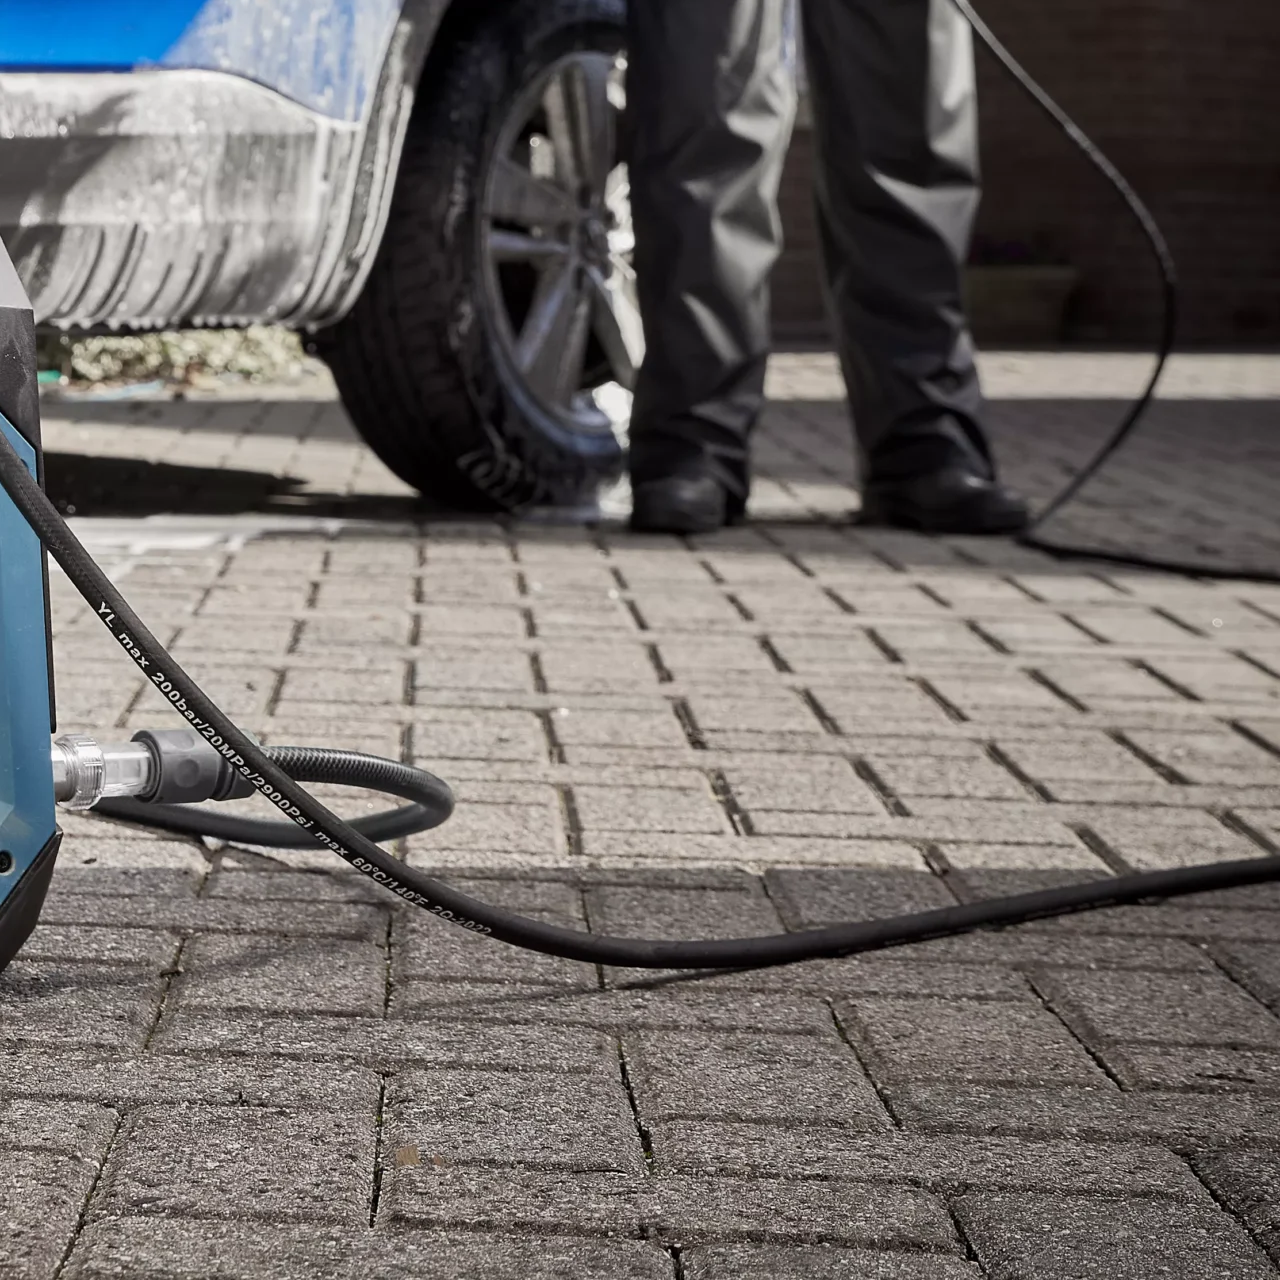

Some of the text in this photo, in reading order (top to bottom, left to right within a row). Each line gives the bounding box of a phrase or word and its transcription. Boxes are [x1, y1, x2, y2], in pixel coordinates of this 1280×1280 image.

[98, 601, 118, 628] YL
[118, 632, 150, 668] max
[314, 831, 349, 856] max
